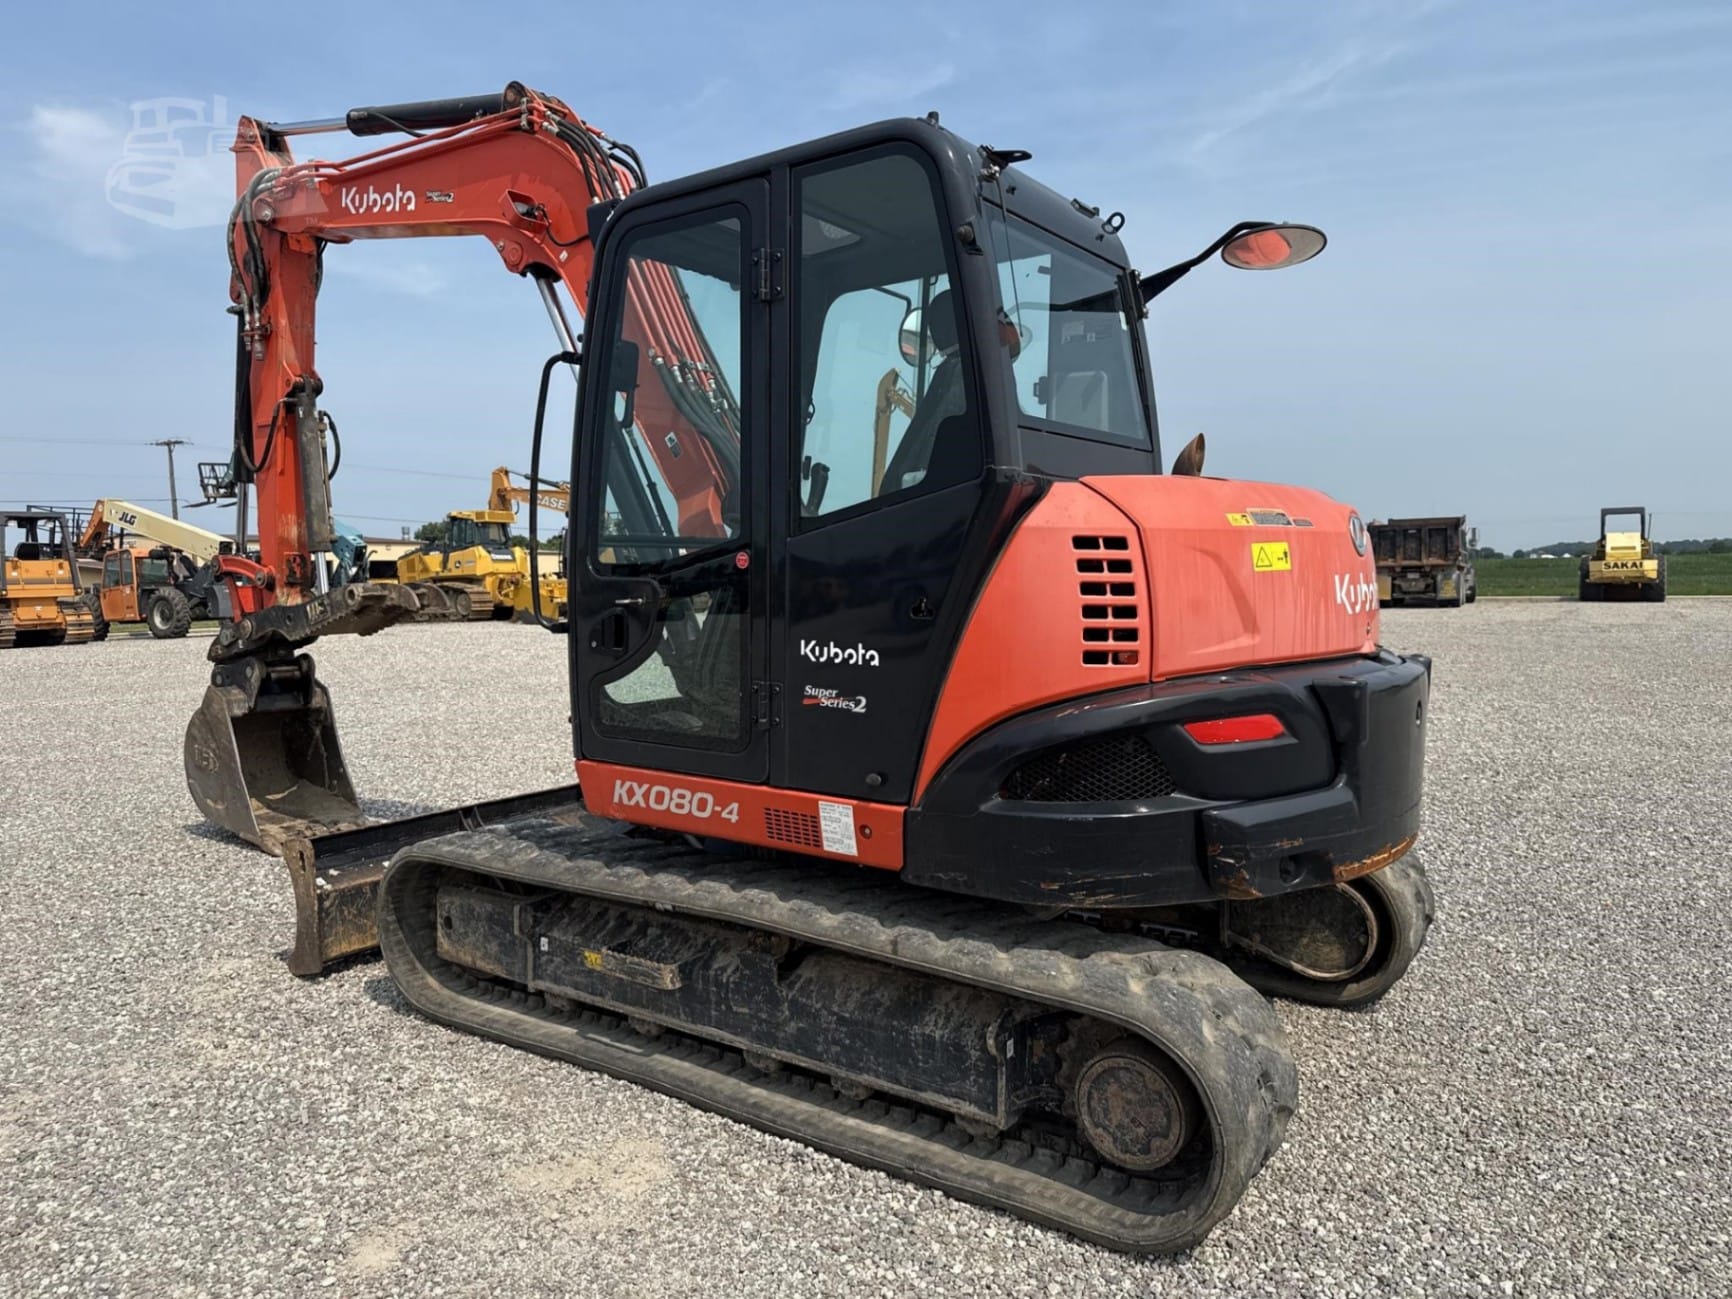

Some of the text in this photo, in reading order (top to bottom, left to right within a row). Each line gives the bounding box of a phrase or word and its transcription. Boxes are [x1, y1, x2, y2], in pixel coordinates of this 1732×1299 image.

[341, 183, 416, 214] Kubota
[118, 511, 137, 526] JLG
[1603, 561, 1643, 570] SAKAI
[800, 639, 879, 667] Kubota
[803, 684, 838, 698] Super
[612, 779, 739, 823] KX080-4
